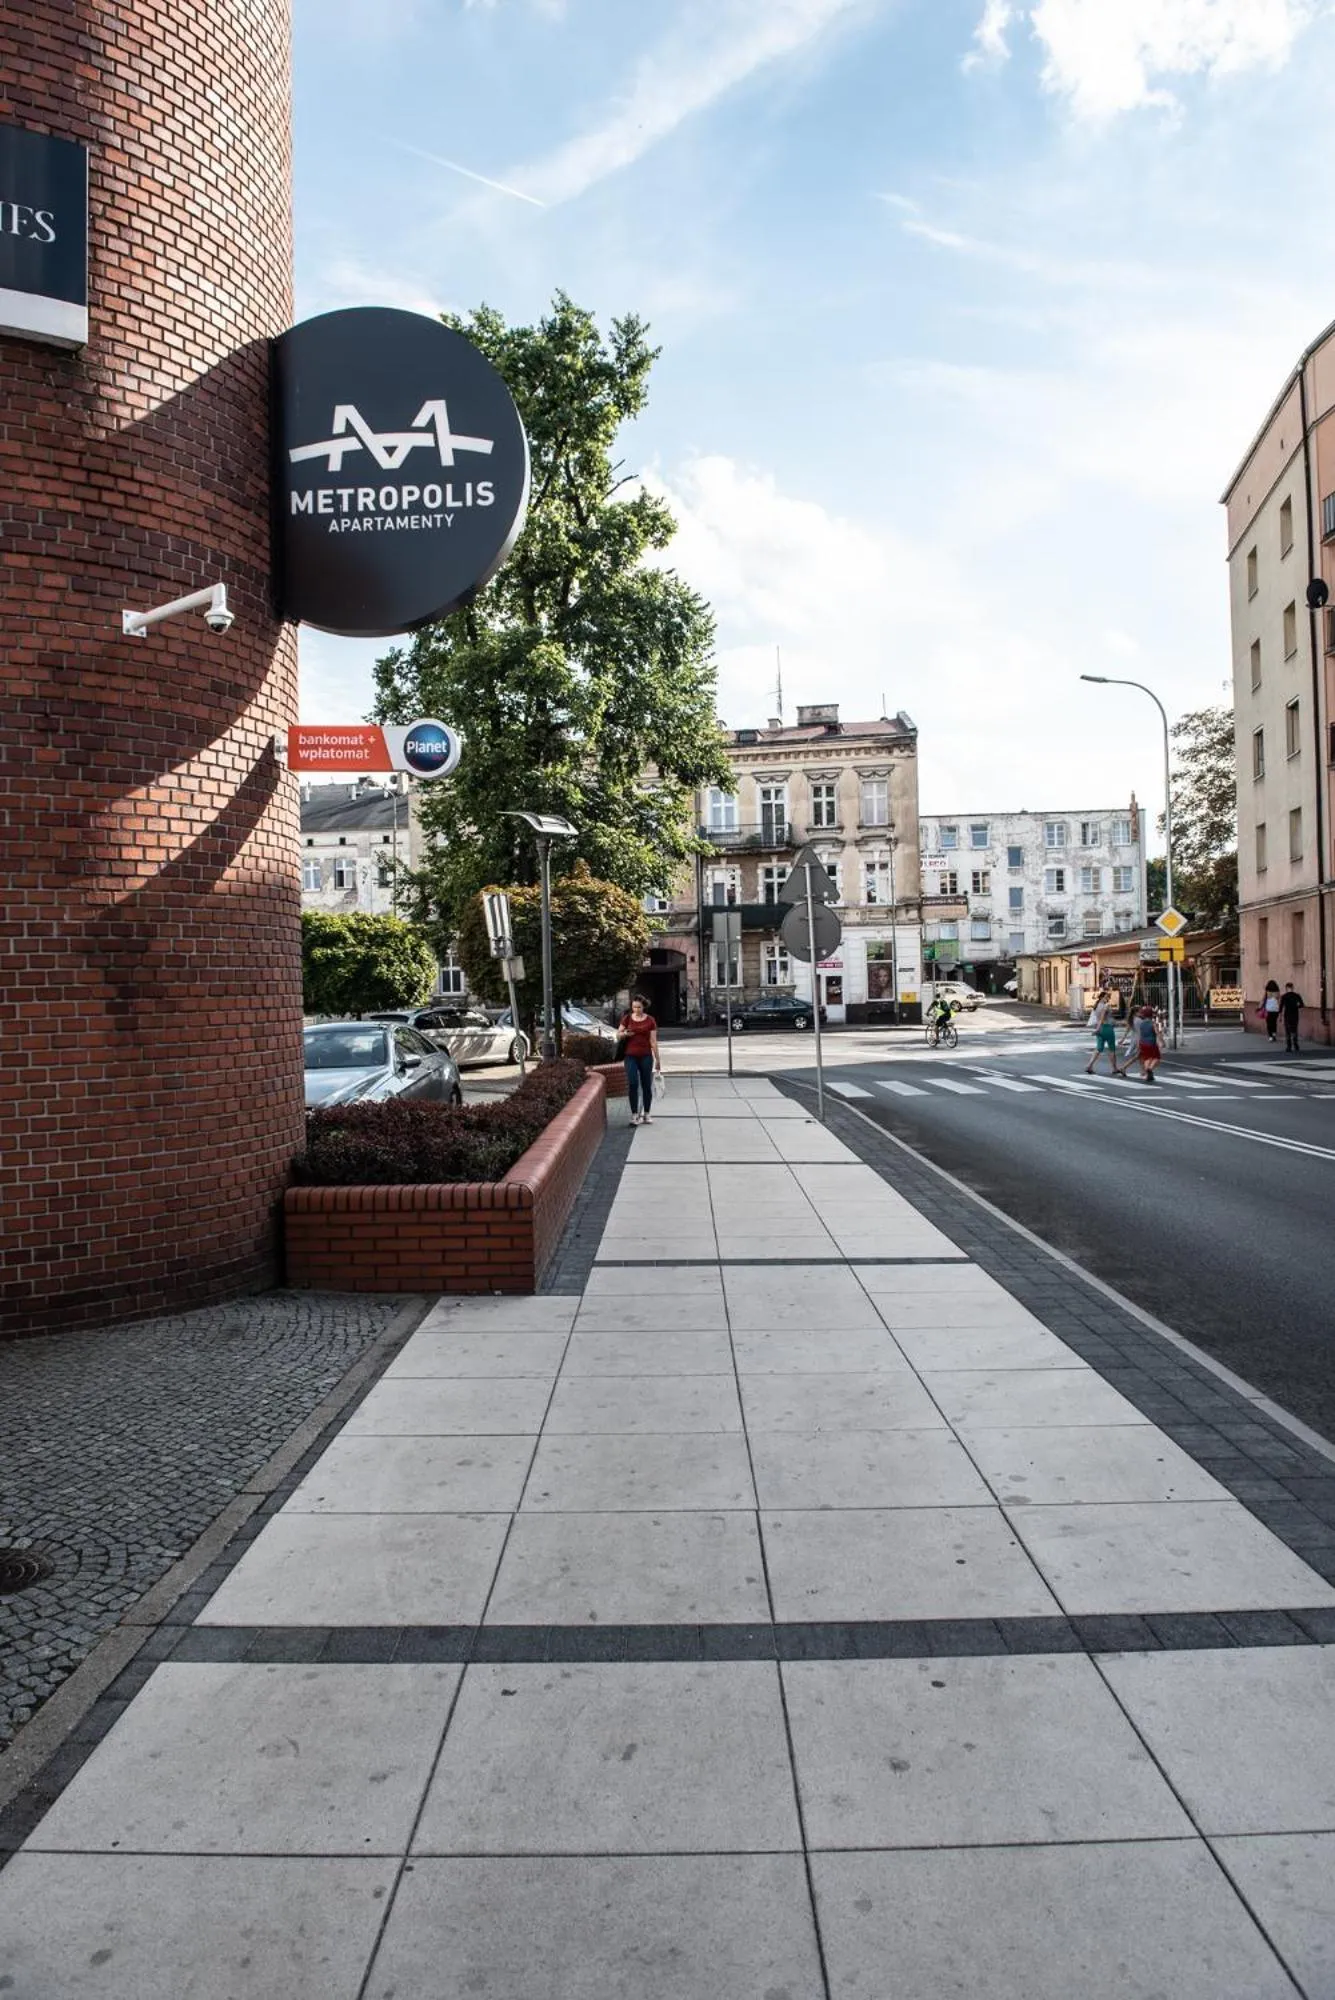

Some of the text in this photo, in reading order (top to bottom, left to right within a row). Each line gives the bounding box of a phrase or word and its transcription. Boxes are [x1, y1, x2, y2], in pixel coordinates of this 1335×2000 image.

[290, 481, 495, 516] METROPOLIS
[328, 513, 455, 533] APARTAMENTY
[298, 734, 364, 746] bankomat
[406, 740, 448, 754] Planet
[298, 747, 371, 762] wpłatomat
